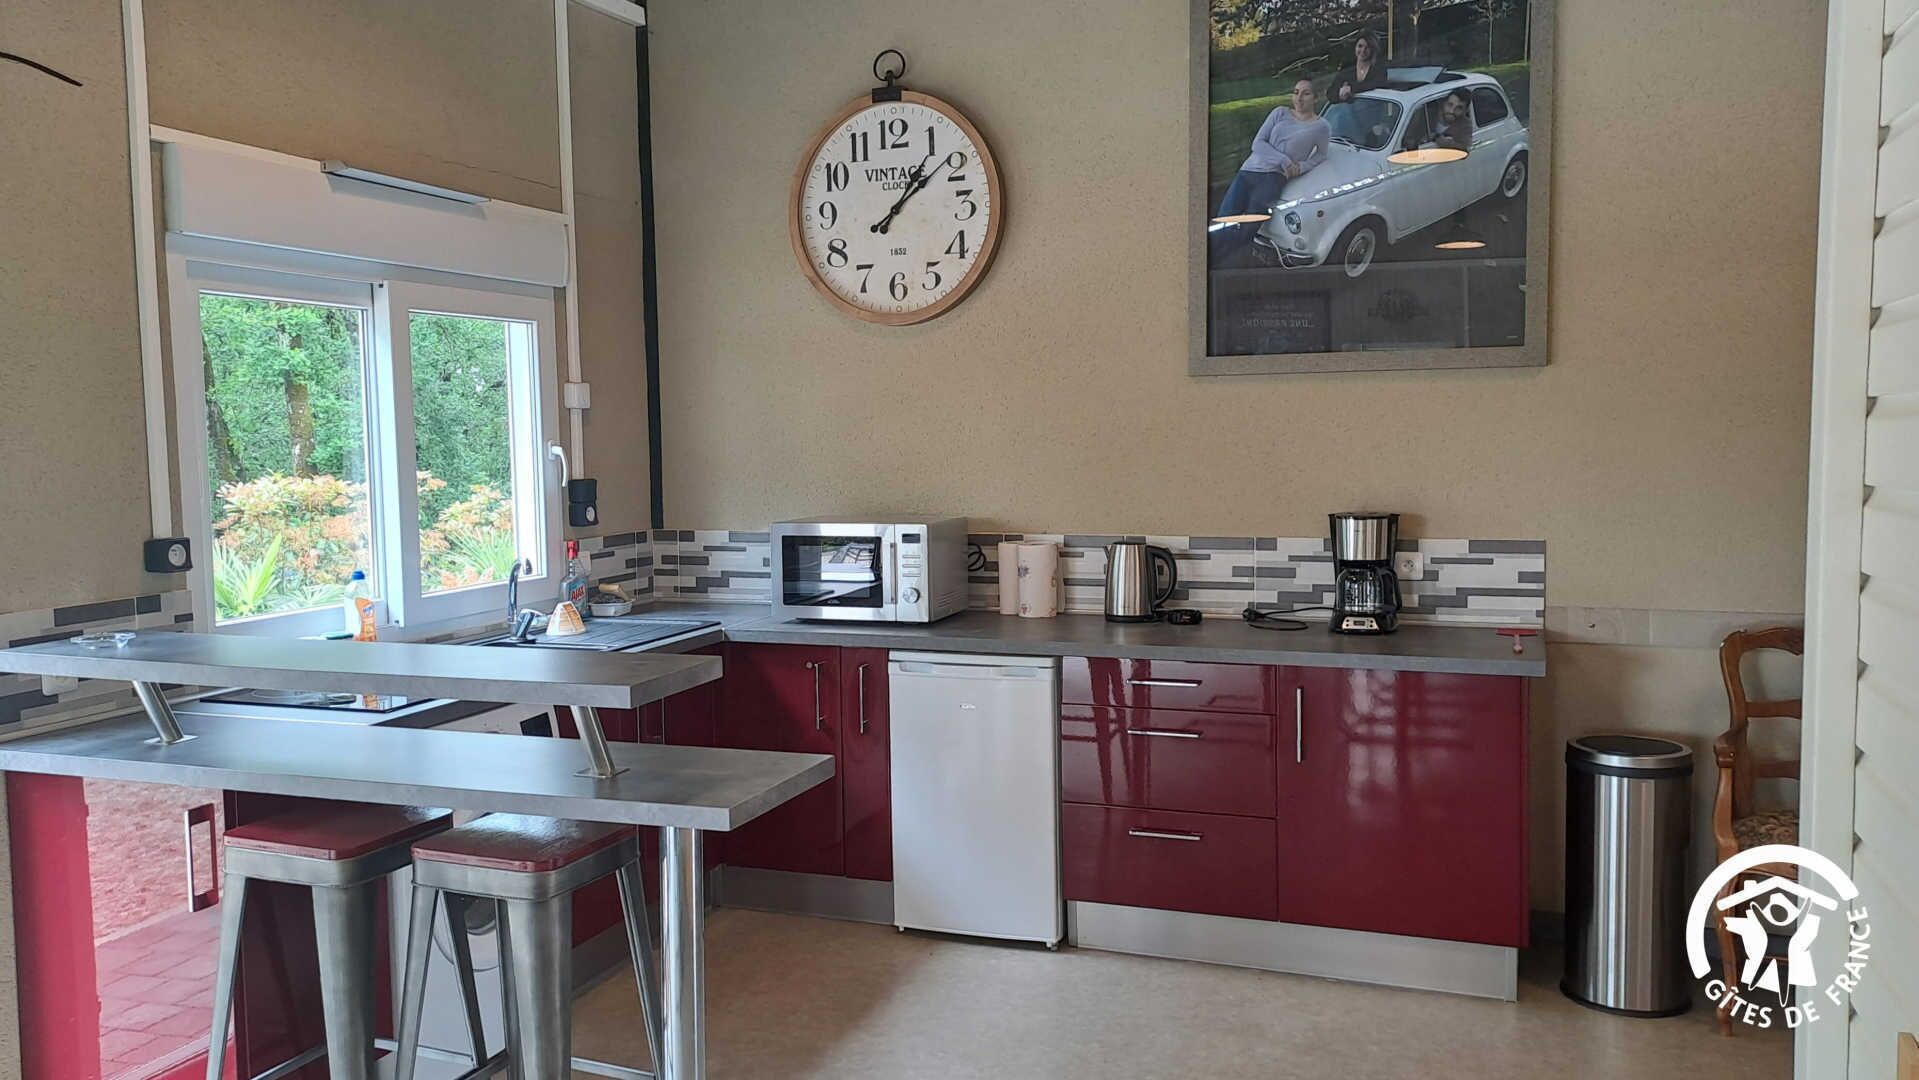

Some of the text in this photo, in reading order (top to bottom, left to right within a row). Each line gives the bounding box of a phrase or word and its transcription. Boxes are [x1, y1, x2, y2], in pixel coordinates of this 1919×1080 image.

[850, 132, 870, 163] 11
[878, 118, 909, 150] 12
[924, 126, 936, 156] 1
[825, 161, 850, 192] 10
[947, 151, 968, 182] 2
[818, 201, 838, 230] 9
[954, 189, 977, 221] 3
[827, 238, 849, 268] 8
[944, 230, 969, 260] 4
[856, 264, 874, 294] 7
[889, 272, 908, 301] 6
[922, 261, 942, 291] 5
